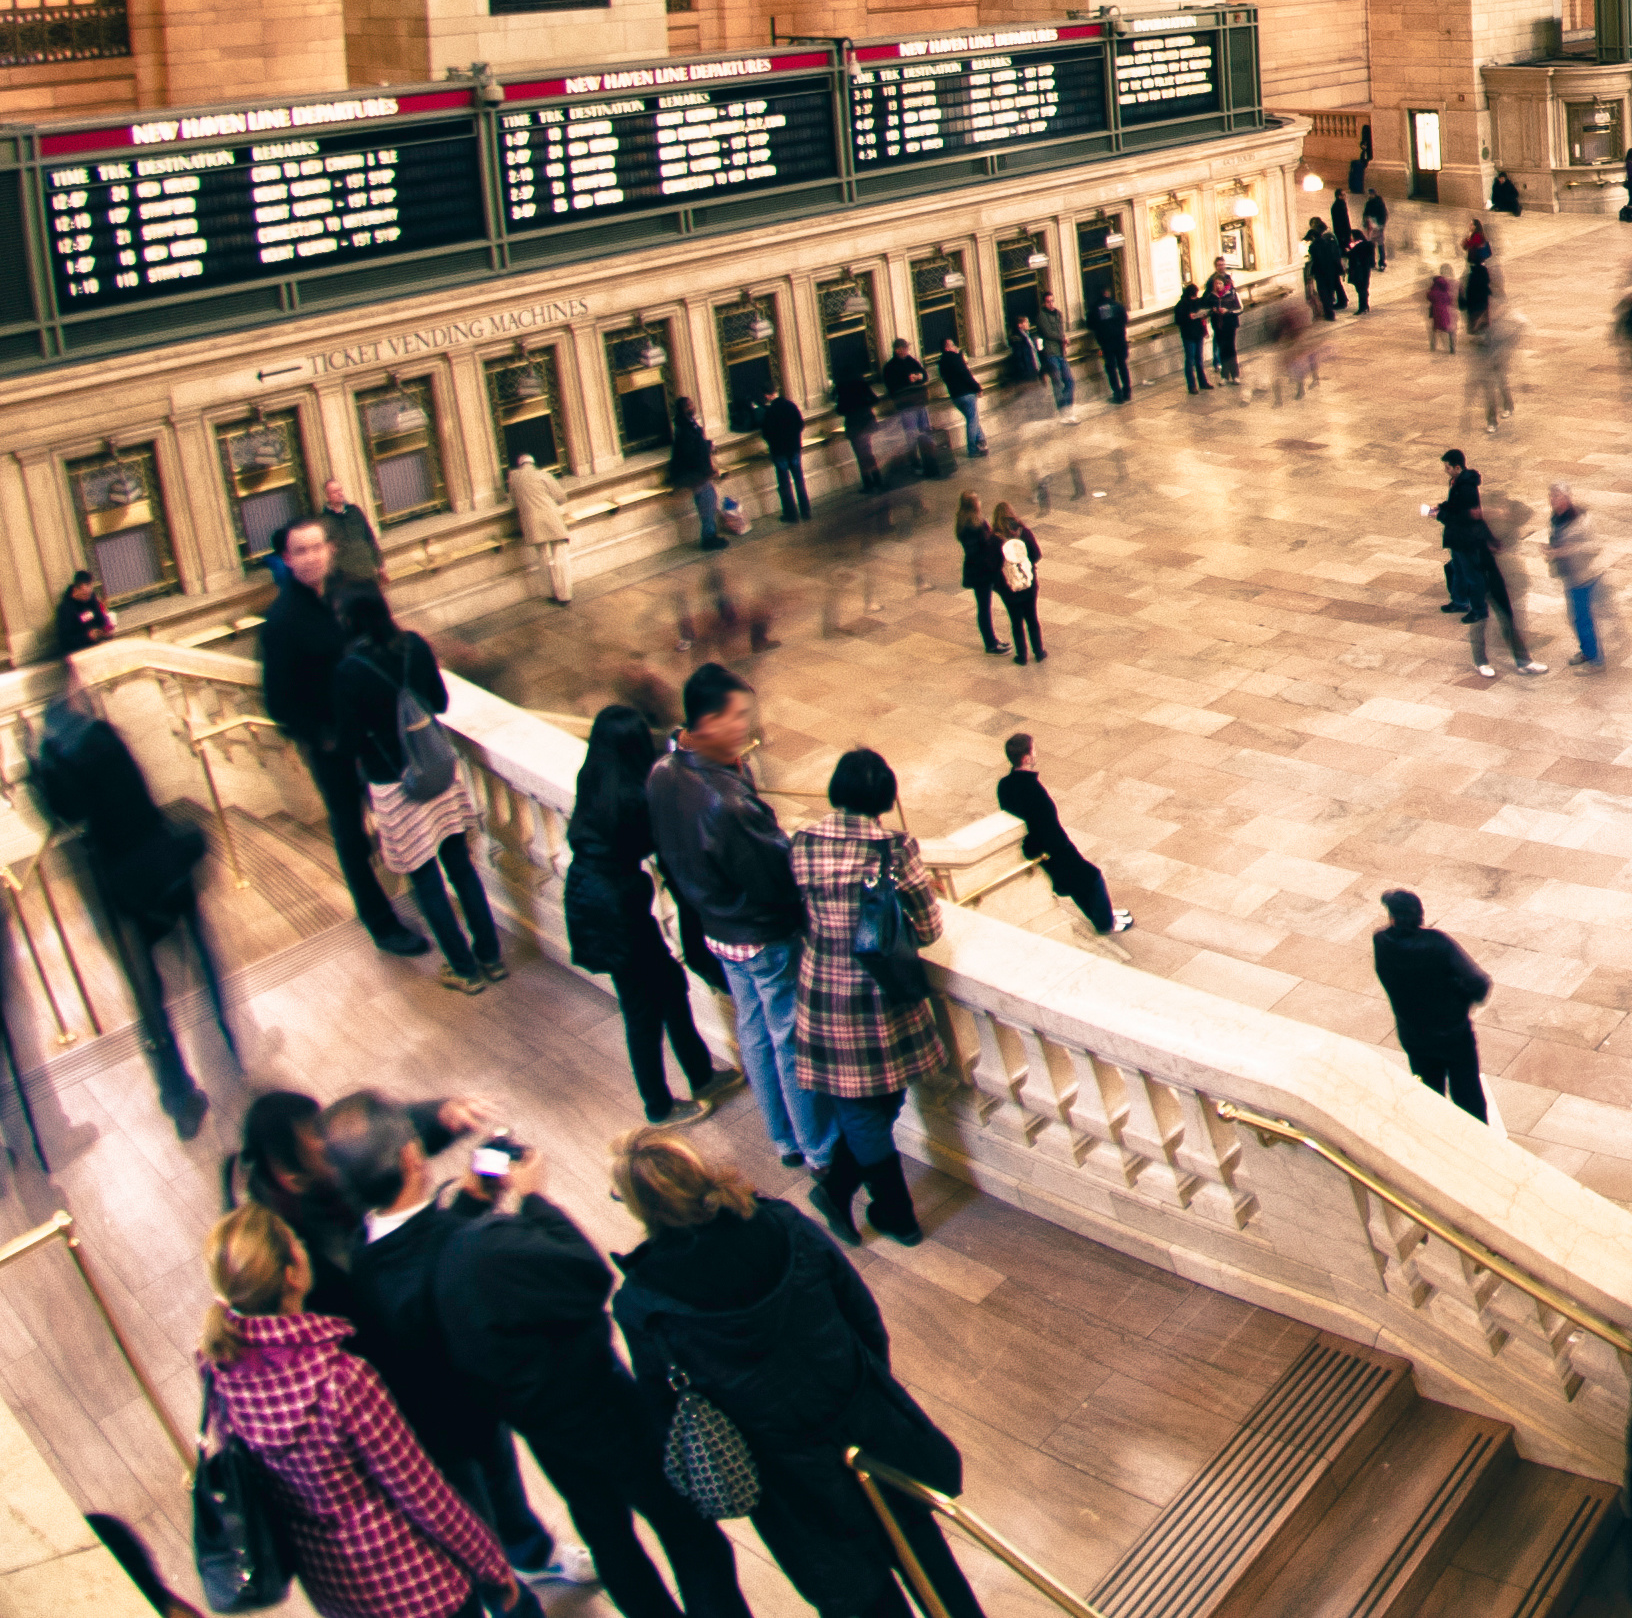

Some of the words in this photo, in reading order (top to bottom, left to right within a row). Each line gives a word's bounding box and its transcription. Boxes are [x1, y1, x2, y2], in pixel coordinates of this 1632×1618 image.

[899, 41, 928, 57] NEW
[928, 37, 968, 54] HAVEN
[968, 34, 995, 50] LINE
[994, 28, 1058, 47] DEPARTURES
[565, 76, 601, 94] NEW
[603, 70, 654, 90] HAVEN
[655, 66, 689, 83] LINE
[689, 58, 772, 80] DEPARTURES
[131, 120, 179, 144] NEW
[180, 113, 247, 139] HAVEN
[248, 108, 291, 131] LINE
[292, 97, 399, 126] DEPARTURES
[502, 113, 532, 128] TIME
[538, 109, 565, 124] TRK
[569, 100, 645, 120] DESTINATION
[658, 92, 710, 108] REMARKS
[50, 167, 90, 187] TIME
[98, 163, 132, 181] TRK
[137, 150, 235, 176] DESTINATION
[252, 141, 319, 161] REMARKS
[307, 341, 381, 375] TICKET
[386, 318, 484, 355] VENDING
[487, 296, 589, 333] MACHINES
